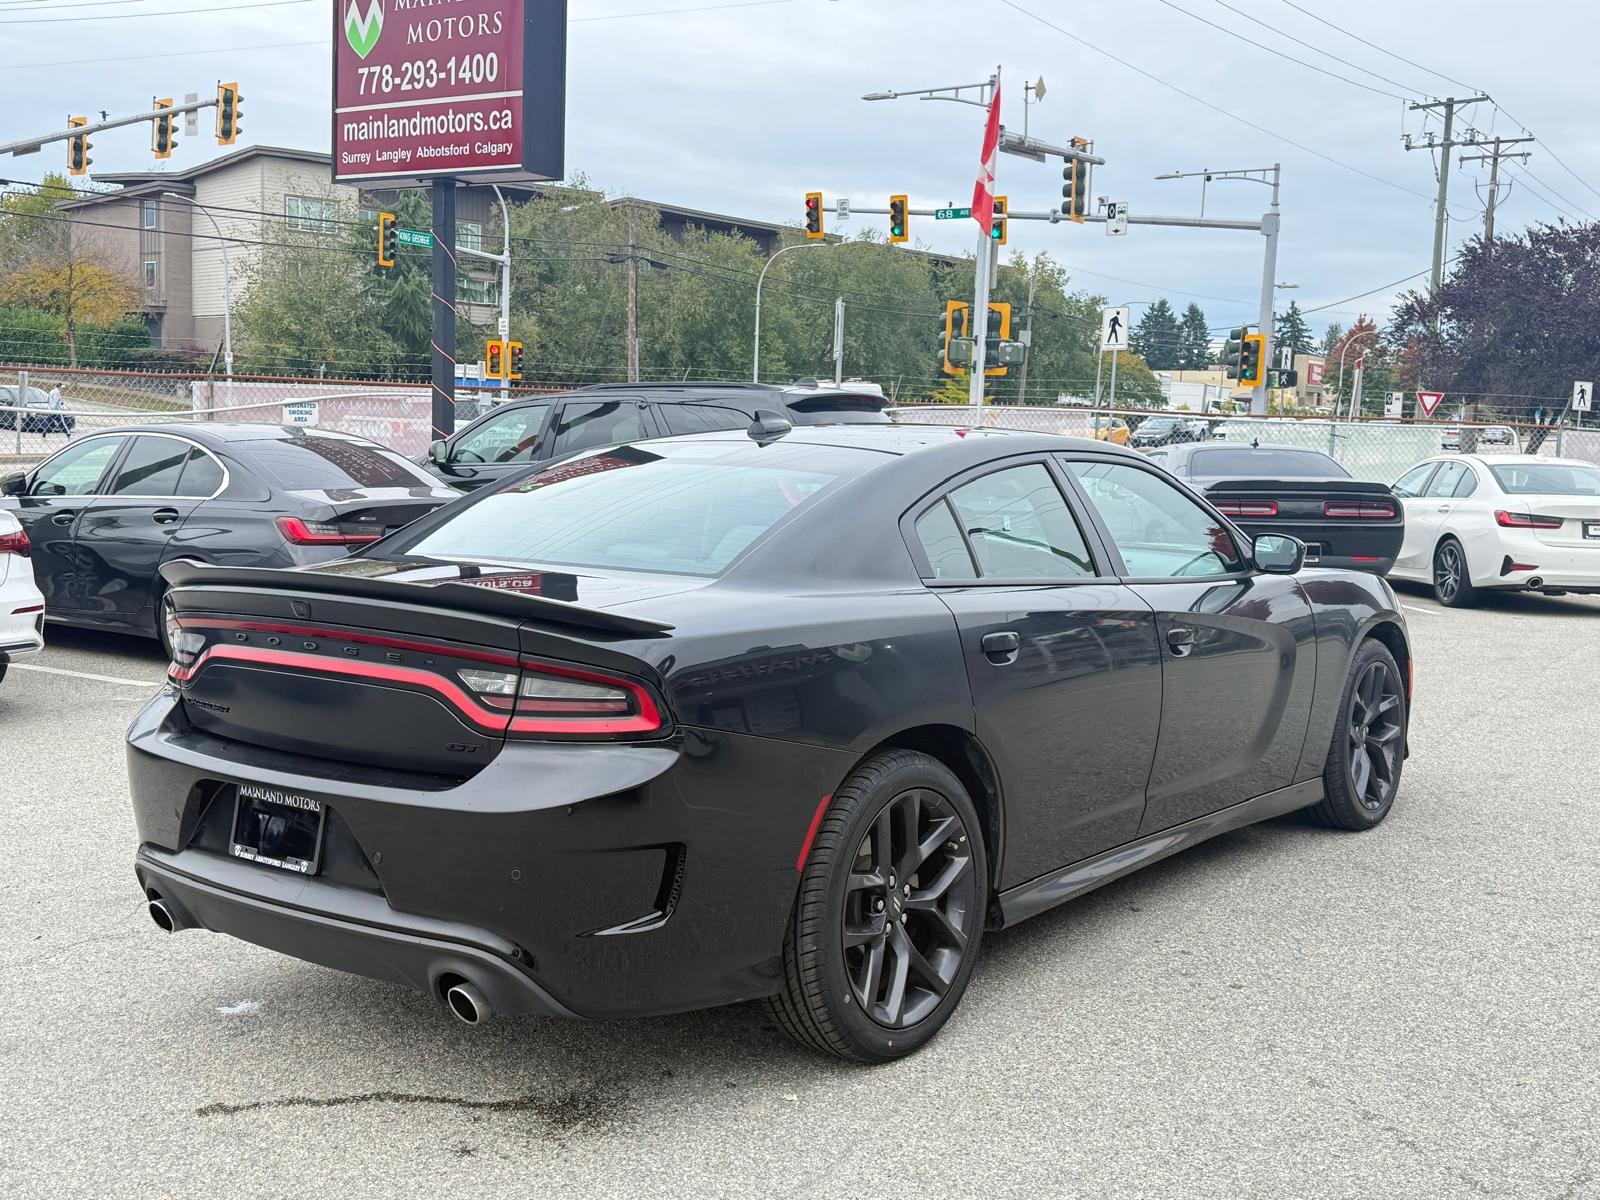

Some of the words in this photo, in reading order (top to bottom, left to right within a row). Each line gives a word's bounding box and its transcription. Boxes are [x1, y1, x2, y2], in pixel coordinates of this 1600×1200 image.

[406, 11, 503, 45] MOTORS
[358, 52, 498, 95] 778-293-1400
[343, 108, 512, 142] mainlandmotors.ca
[342, 151, 371, 164] Surrey
[376, 148, 412, 163] Langley
[416, 143, 470, 158] Abbotsford
[474, 141, 513, 156] Calgary
[937, 209, 954, 219] 68
[236, 632, 402, 662] DODGE
[240, 785, 283, 804] MAINLAND
[285, 794, 320, 812] MOTORS
